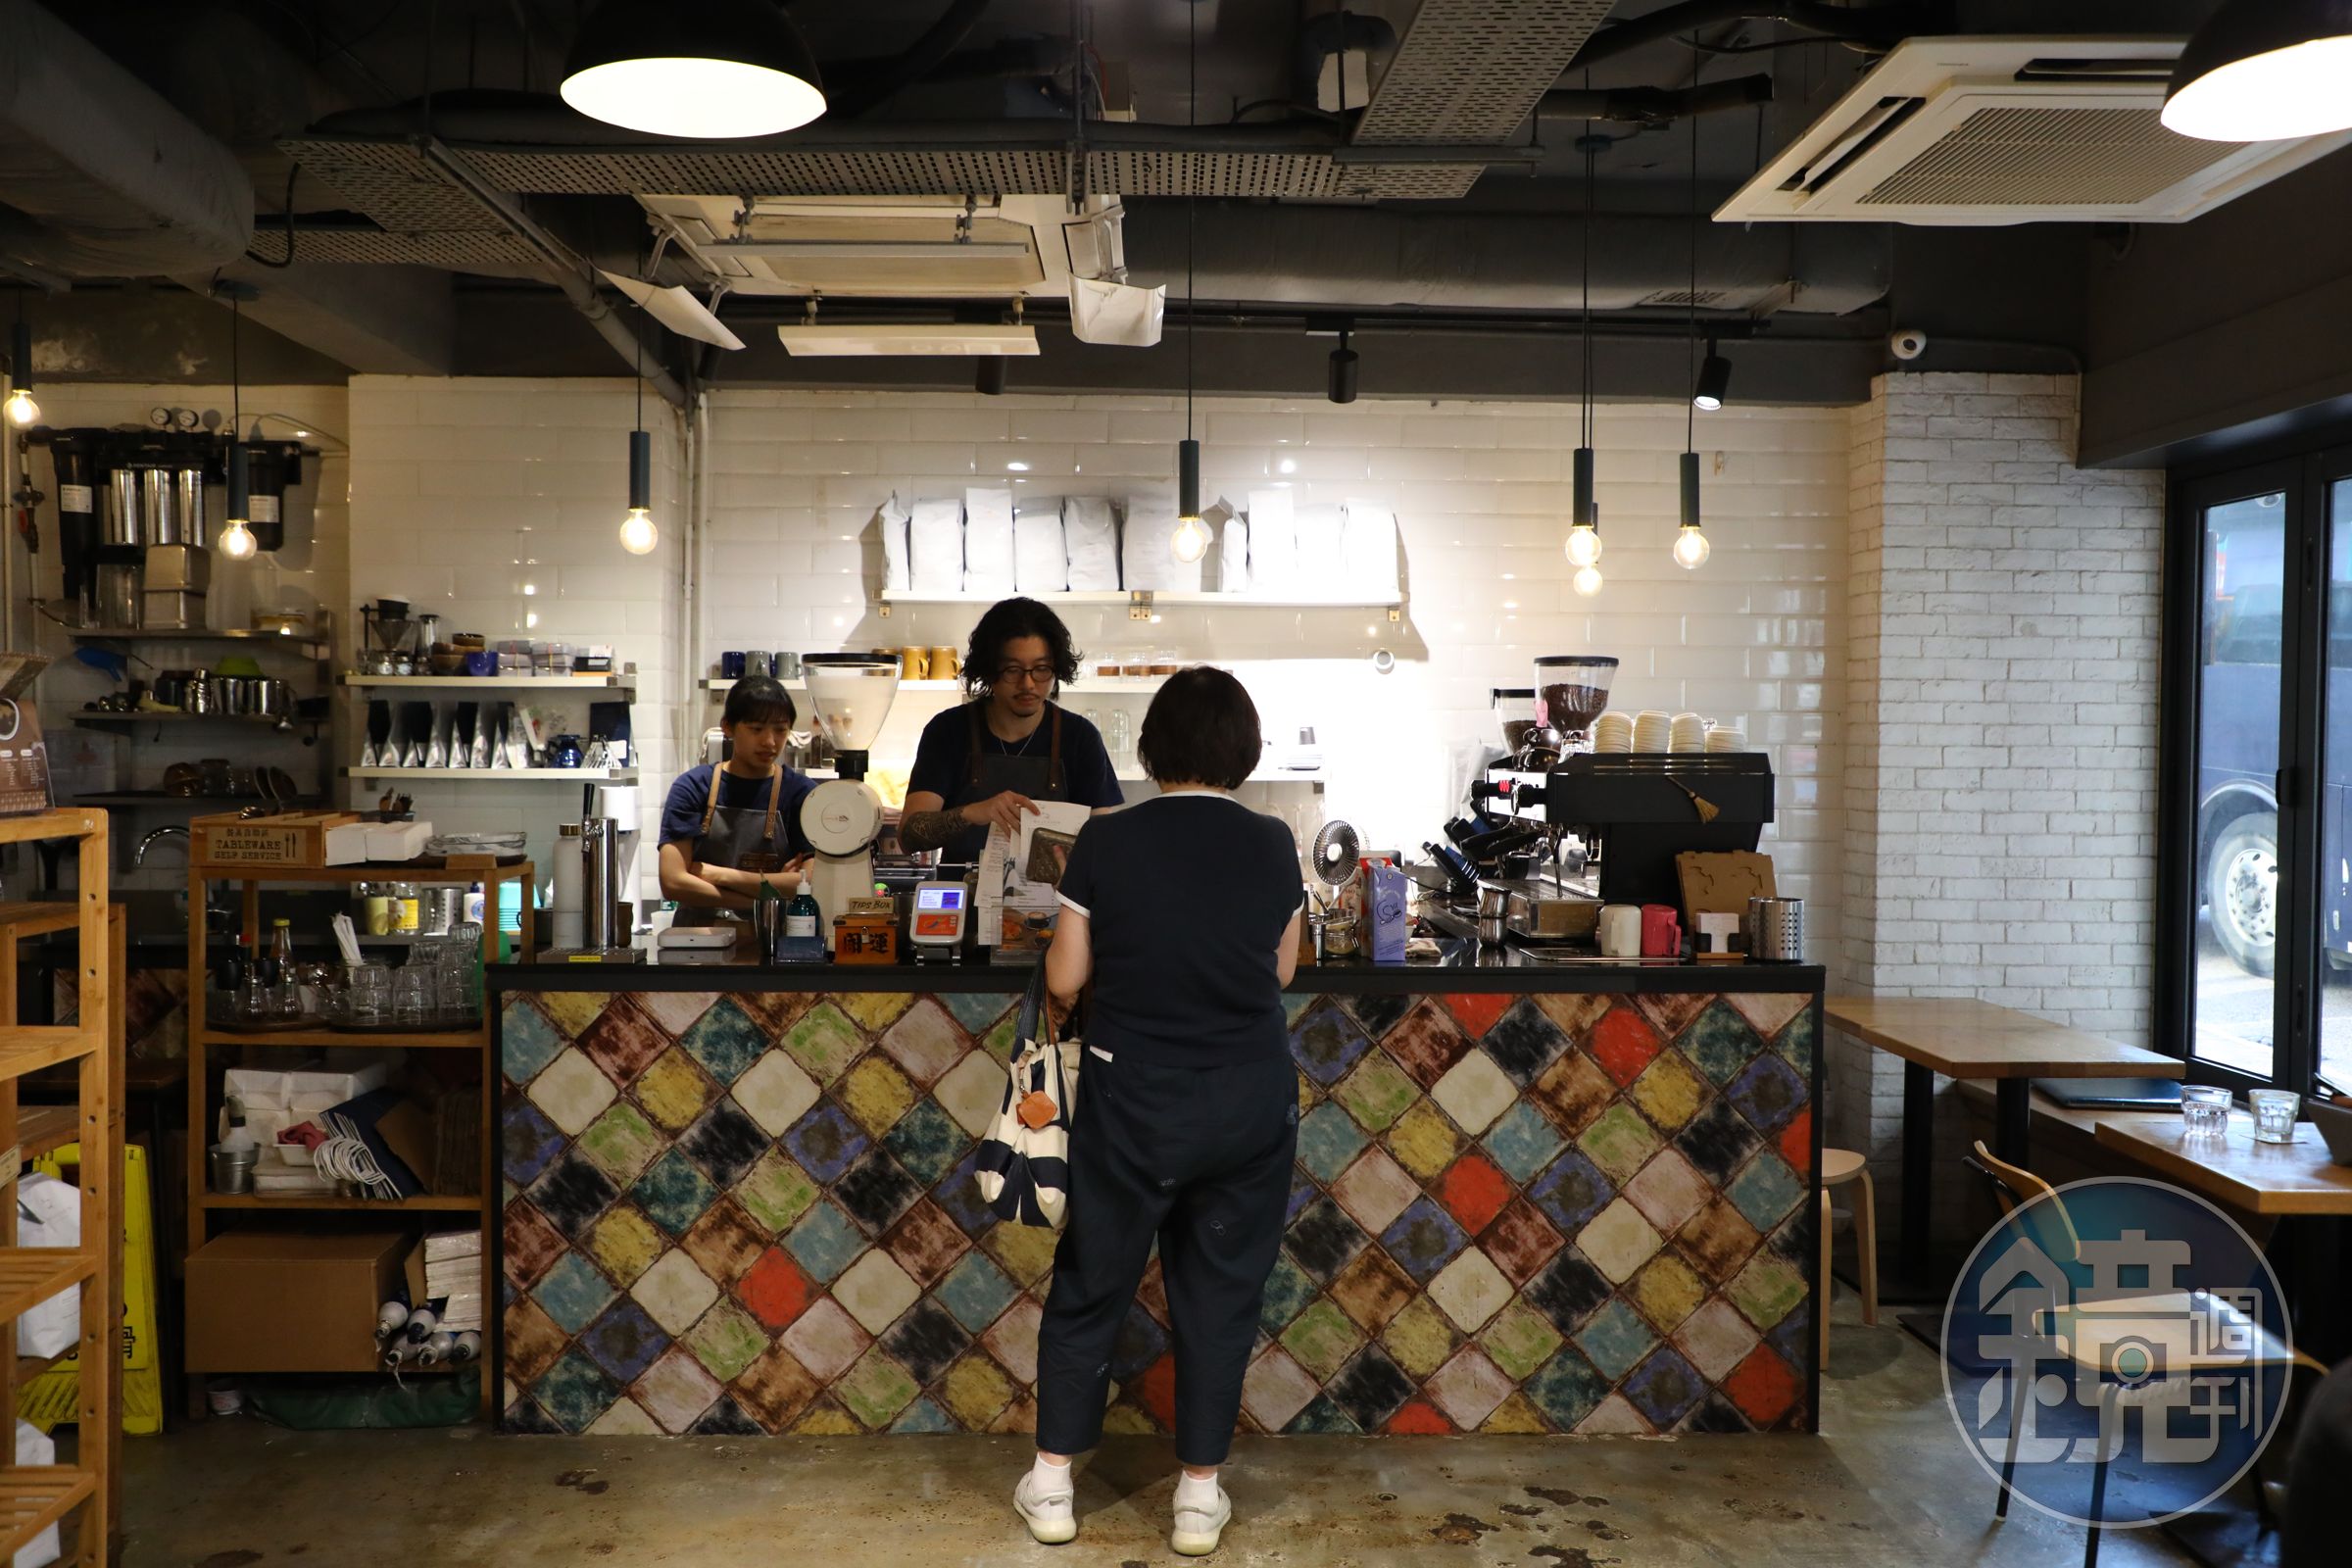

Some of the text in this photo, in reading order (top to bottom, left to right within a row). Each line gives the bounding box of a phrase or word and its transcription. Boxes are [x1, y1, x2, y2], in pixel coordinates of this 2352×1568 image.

[216, 839, 281, 851] TABLEWARE
[214, 851, 282, 860] SELF SERVICE
[852, 900, 891, 909] TIPS BOX
